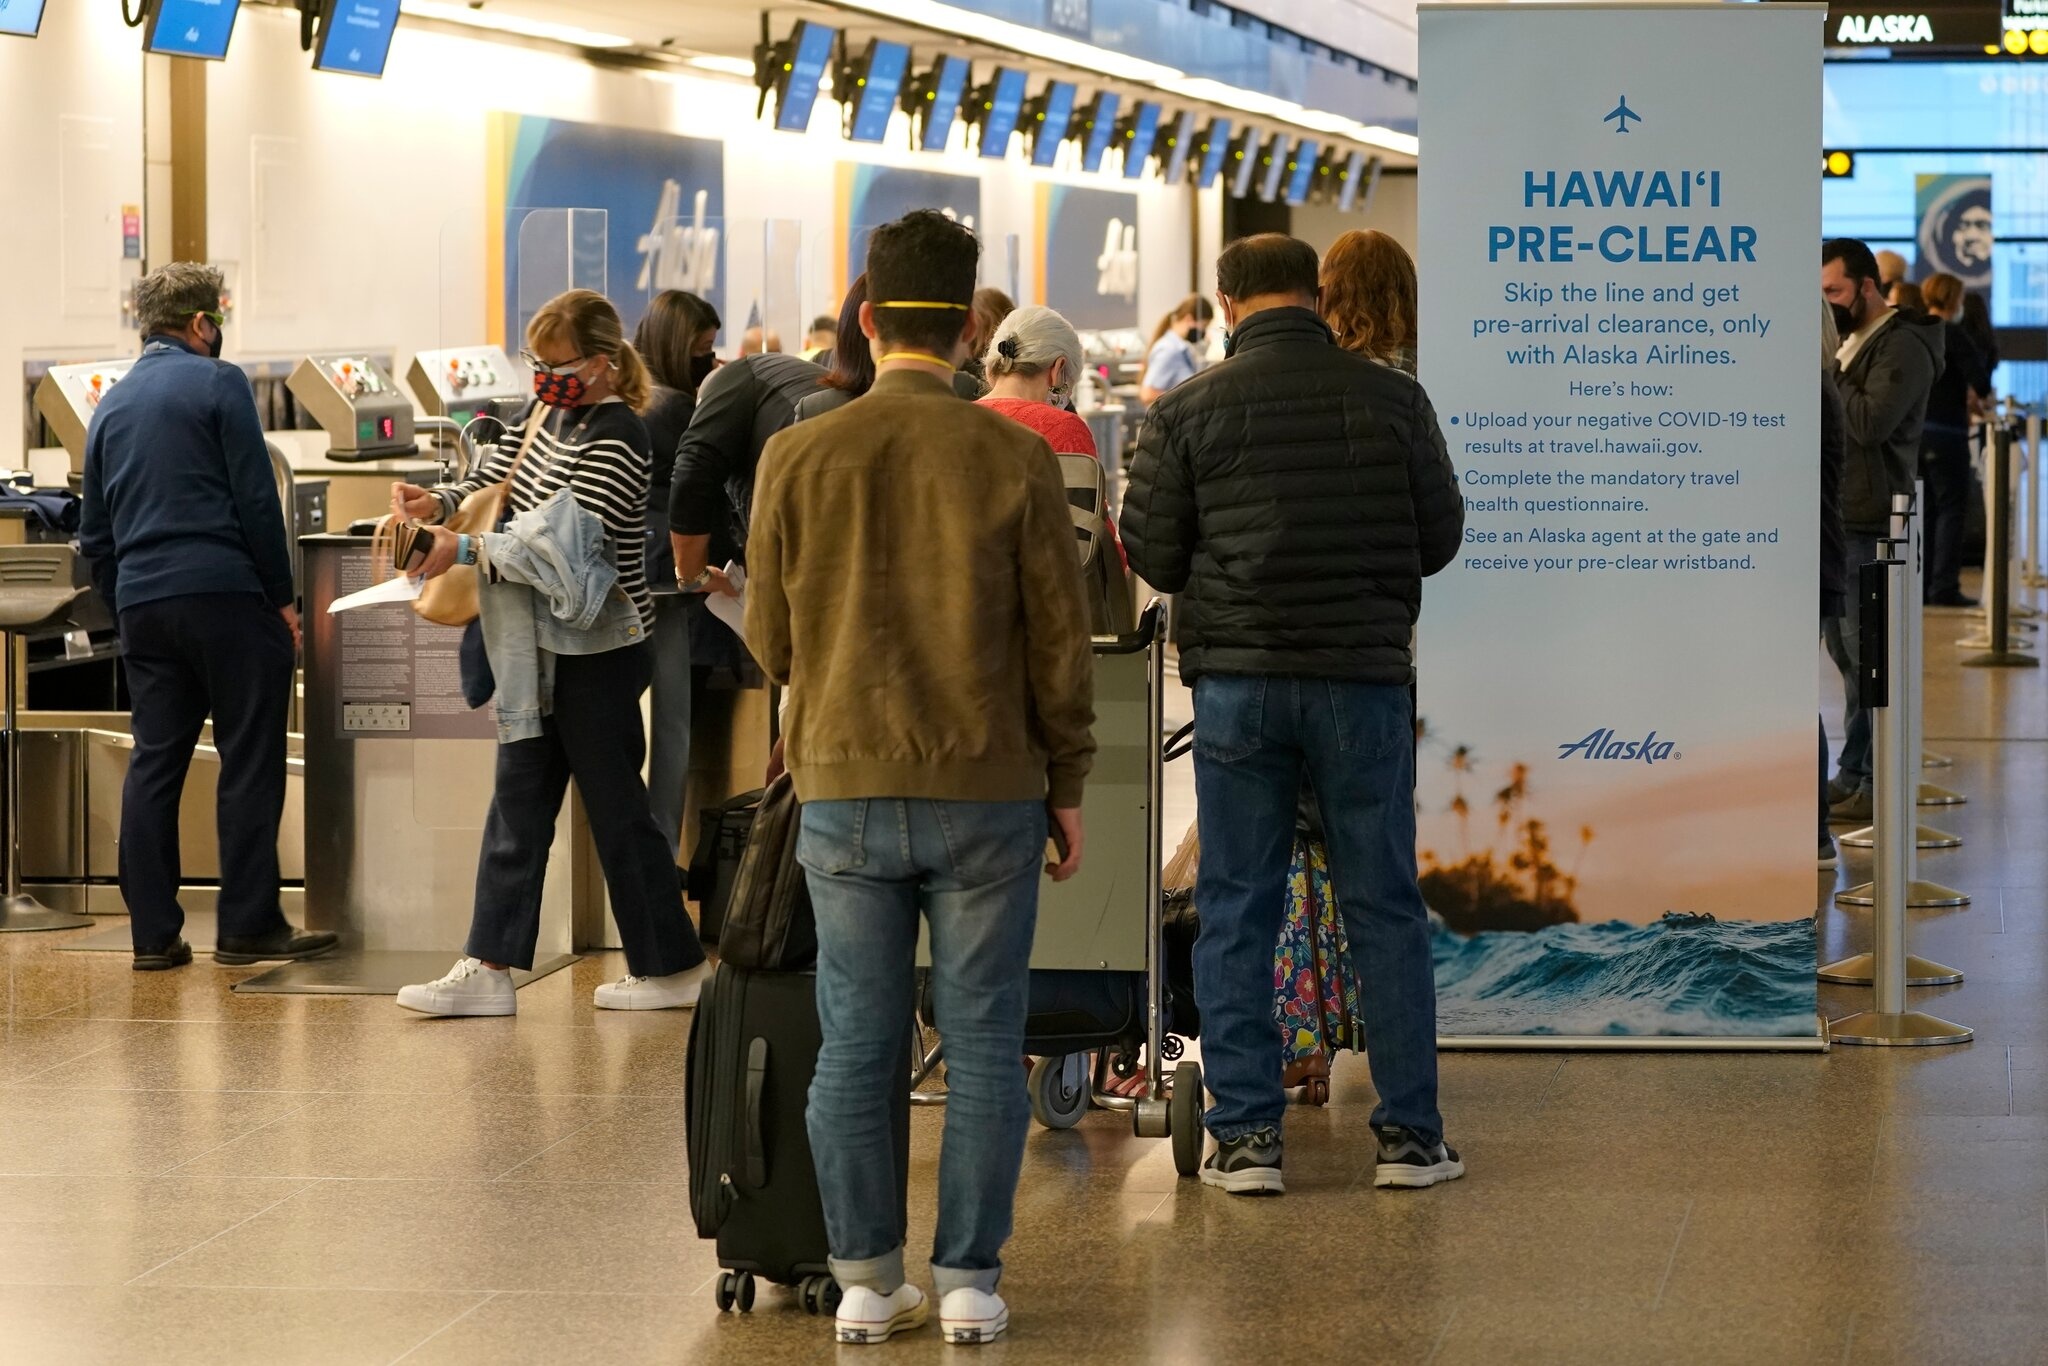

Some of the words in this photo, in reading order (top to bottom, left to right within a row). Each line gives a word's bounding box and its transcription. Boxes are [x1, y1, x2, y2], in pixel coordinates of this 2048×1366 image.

[1837, 14, 1934, 43] ALASKA
[1488, 224, 1757, 263] PRE-CLEAR
[1504, 281, 1553, 306] Skip
[1560, 281, 1597, 302] the
[1605, 281, 1644, 302] line
[1652, 281, 1693, 302] and
[1702, 283, 1739, 307] get
[1473, 312, 1588, 338] pre-arrival
[1597, 312, 1714, 336] clearance,
[1722, 312, 1770, 338] only
[1505, 344, 1554, 364] with
[1562, 343, 1637, 364] Alaska
[1645, 344, 1736, 364] Airlines.
[1630, 380, 1672, 396] how:
[1465, 411, 1527, 430] Upload
[1532, 415, 1572, 430] your
[1577, 411, 1652, 430] negative
[1658, 411, 1747, 427] COVID-19
[1751, 413, 1785, 427] test
[1465, 437, 1522, 453] results
[1527, 439, 1544, 453] at
[1549, 437, 1702, 457] travel.hawaii.gov.
[1464, 469, 1551, 488] Complete
[1556, 469, 1584, 484] the
[1590, 469, 1685, 488] mandatory
[1689, 469, 1739, 485] travel
[1465, 495, 1518, 511] health
[1524, 495, 1648, 514] questionnaire.
[1464, 527, 1497, 543] See
[1502, 531, 1522, 543] an
[1528, 527, 1585, 543] Alaska
[1591, 529, 1641, 546] agent
[1646, 529, 1663, 543] at
[1667, 527, 1696, 543] the
[1701, 529, 1740, 546] gate
[1746, 527, 1778, 543] and
[1464, 553, 1528, 569] receive
[1533, 558, 1573, 573] your
[1578, 553, 1658, 572] pre-clear
[1663, 553, 1755, 569] wristband.
[1558, 727, 1675, 765] Alaska
